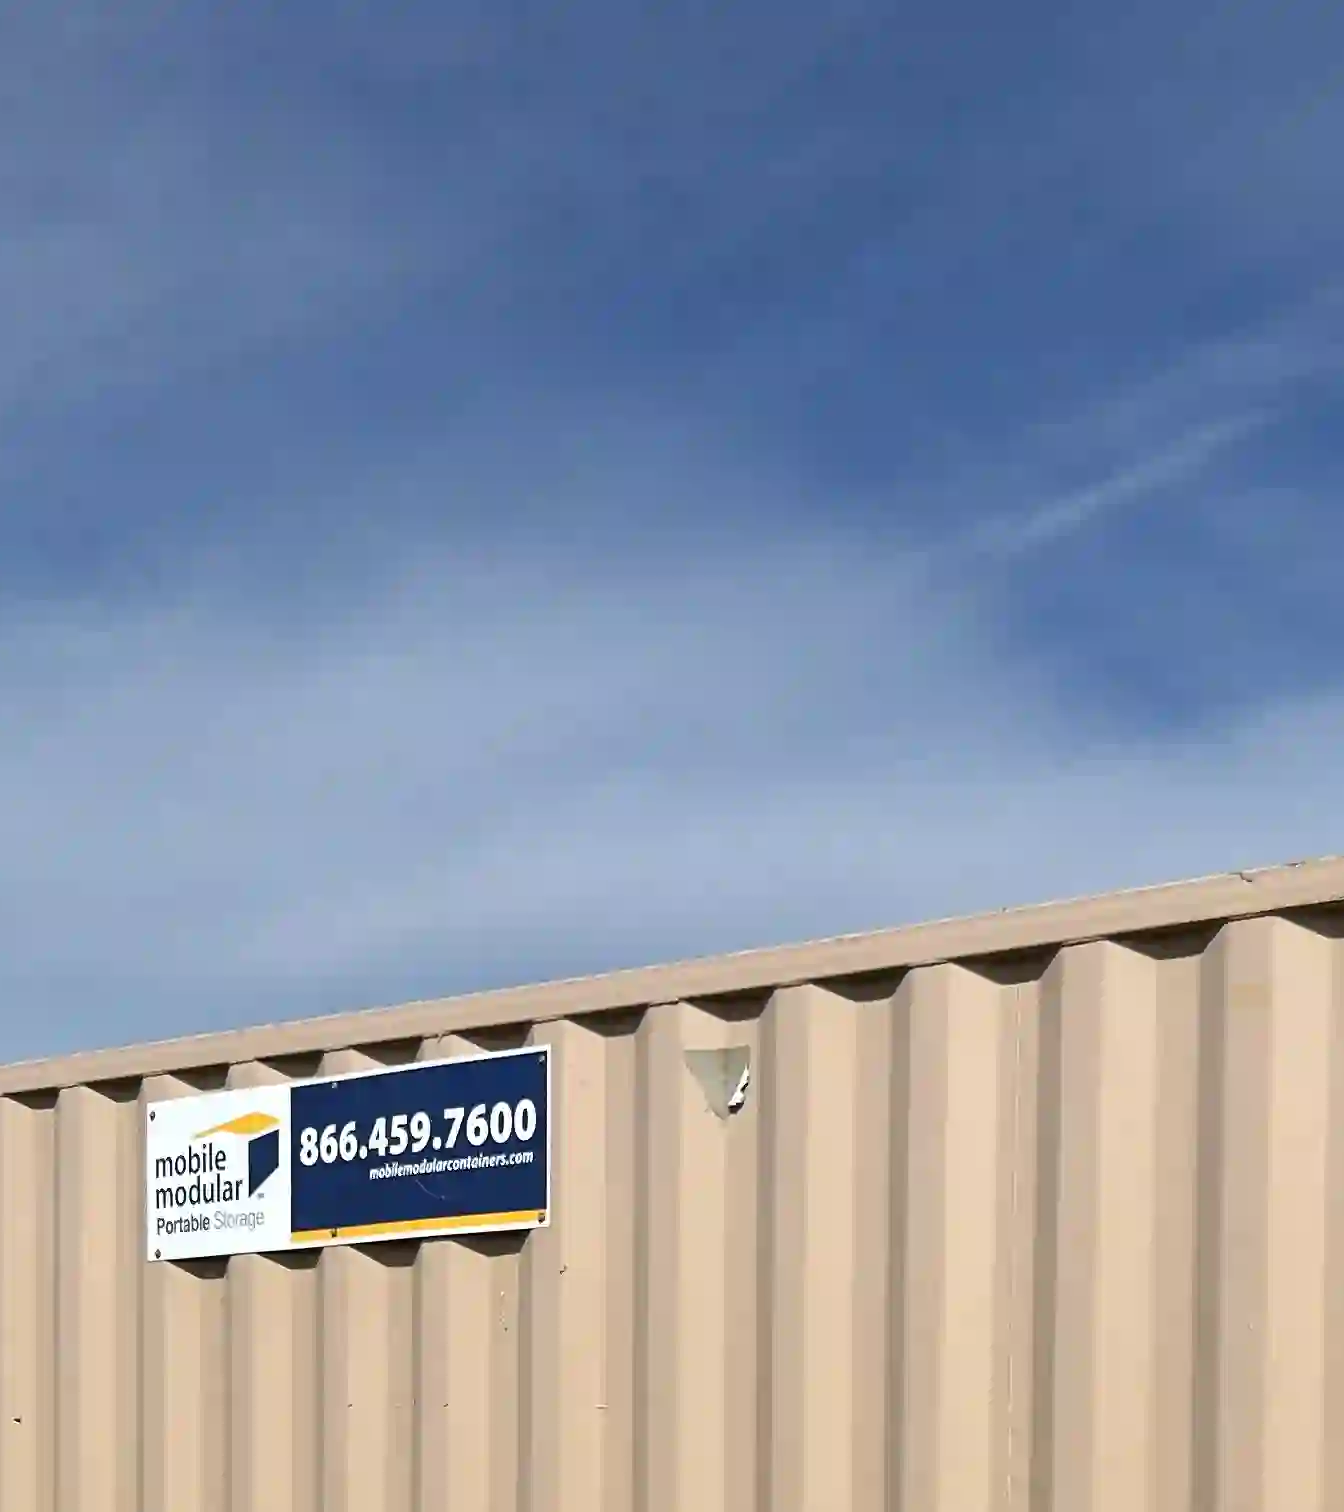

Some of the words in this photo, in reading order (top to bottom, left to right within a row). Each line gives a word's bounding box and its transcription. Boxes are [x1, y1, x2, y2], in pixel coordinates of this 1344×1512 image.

[299, 1098, 537, 1167] 866.459.7600
[155, 1143, 227, 1179] mobile
[369, 1149, 534, 1181] mobilemodularcontainers.com
[155, 1173, 243, 1210] modular
[156, 1213, 210, 1236] Portable
[213, 1209, 265, 1232] Storage
